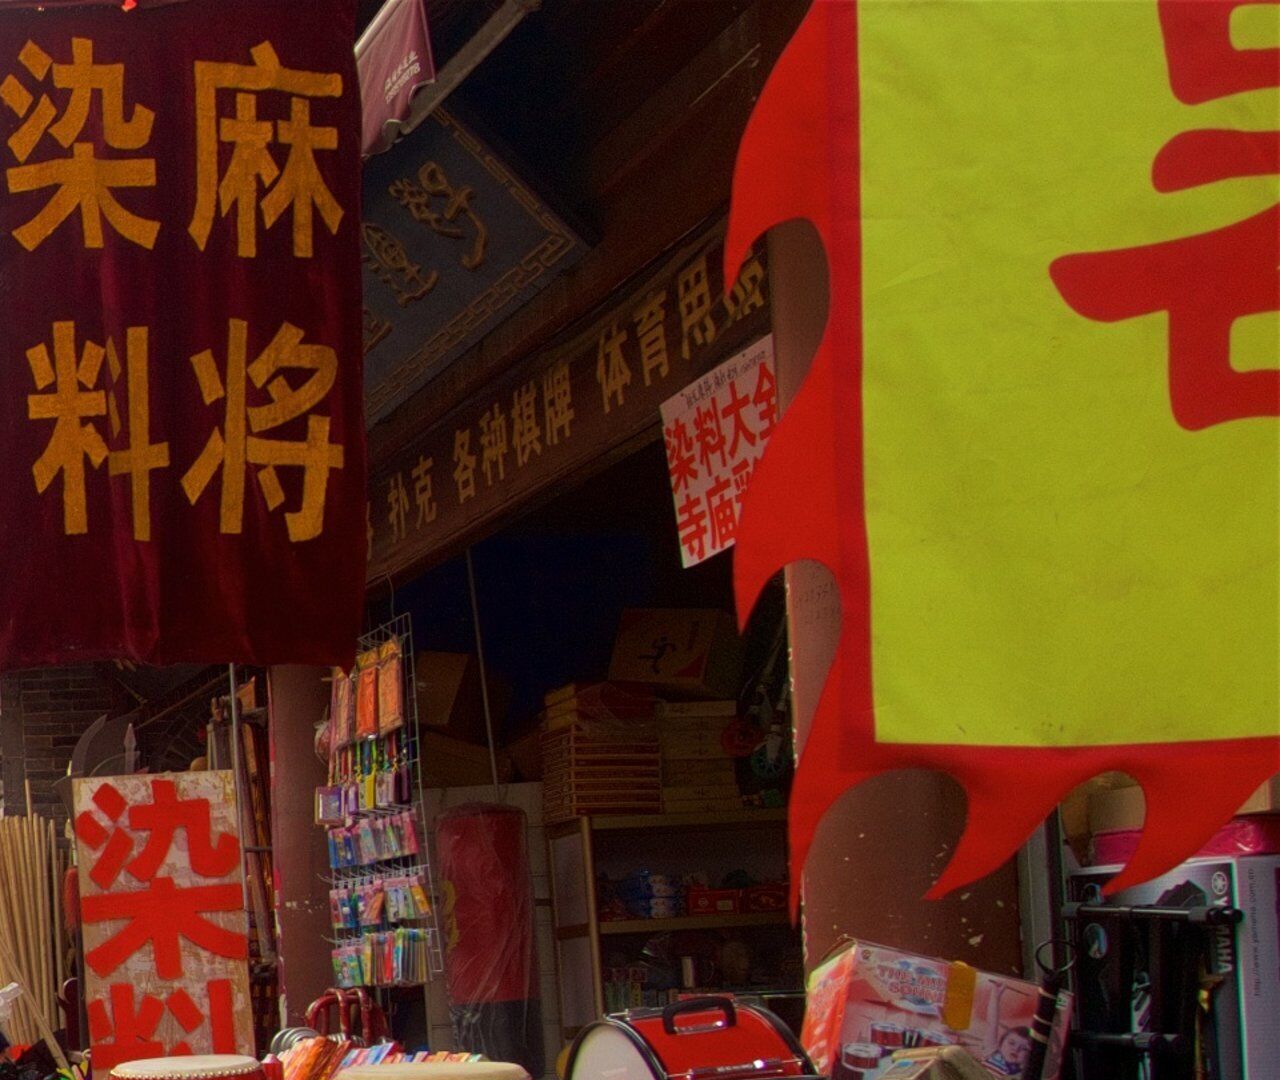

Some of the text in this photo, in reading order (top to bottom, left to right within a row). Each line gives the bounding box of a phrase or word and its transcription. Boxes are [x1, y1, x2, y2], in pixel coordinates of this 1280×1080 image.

[180, 40, 345, 542] 麻将
[452, 361, 577, 503] 各种棋牌
[665, 362, 777, 494] 染料大全
[1212, 896, 1234, 974] YMAHA
